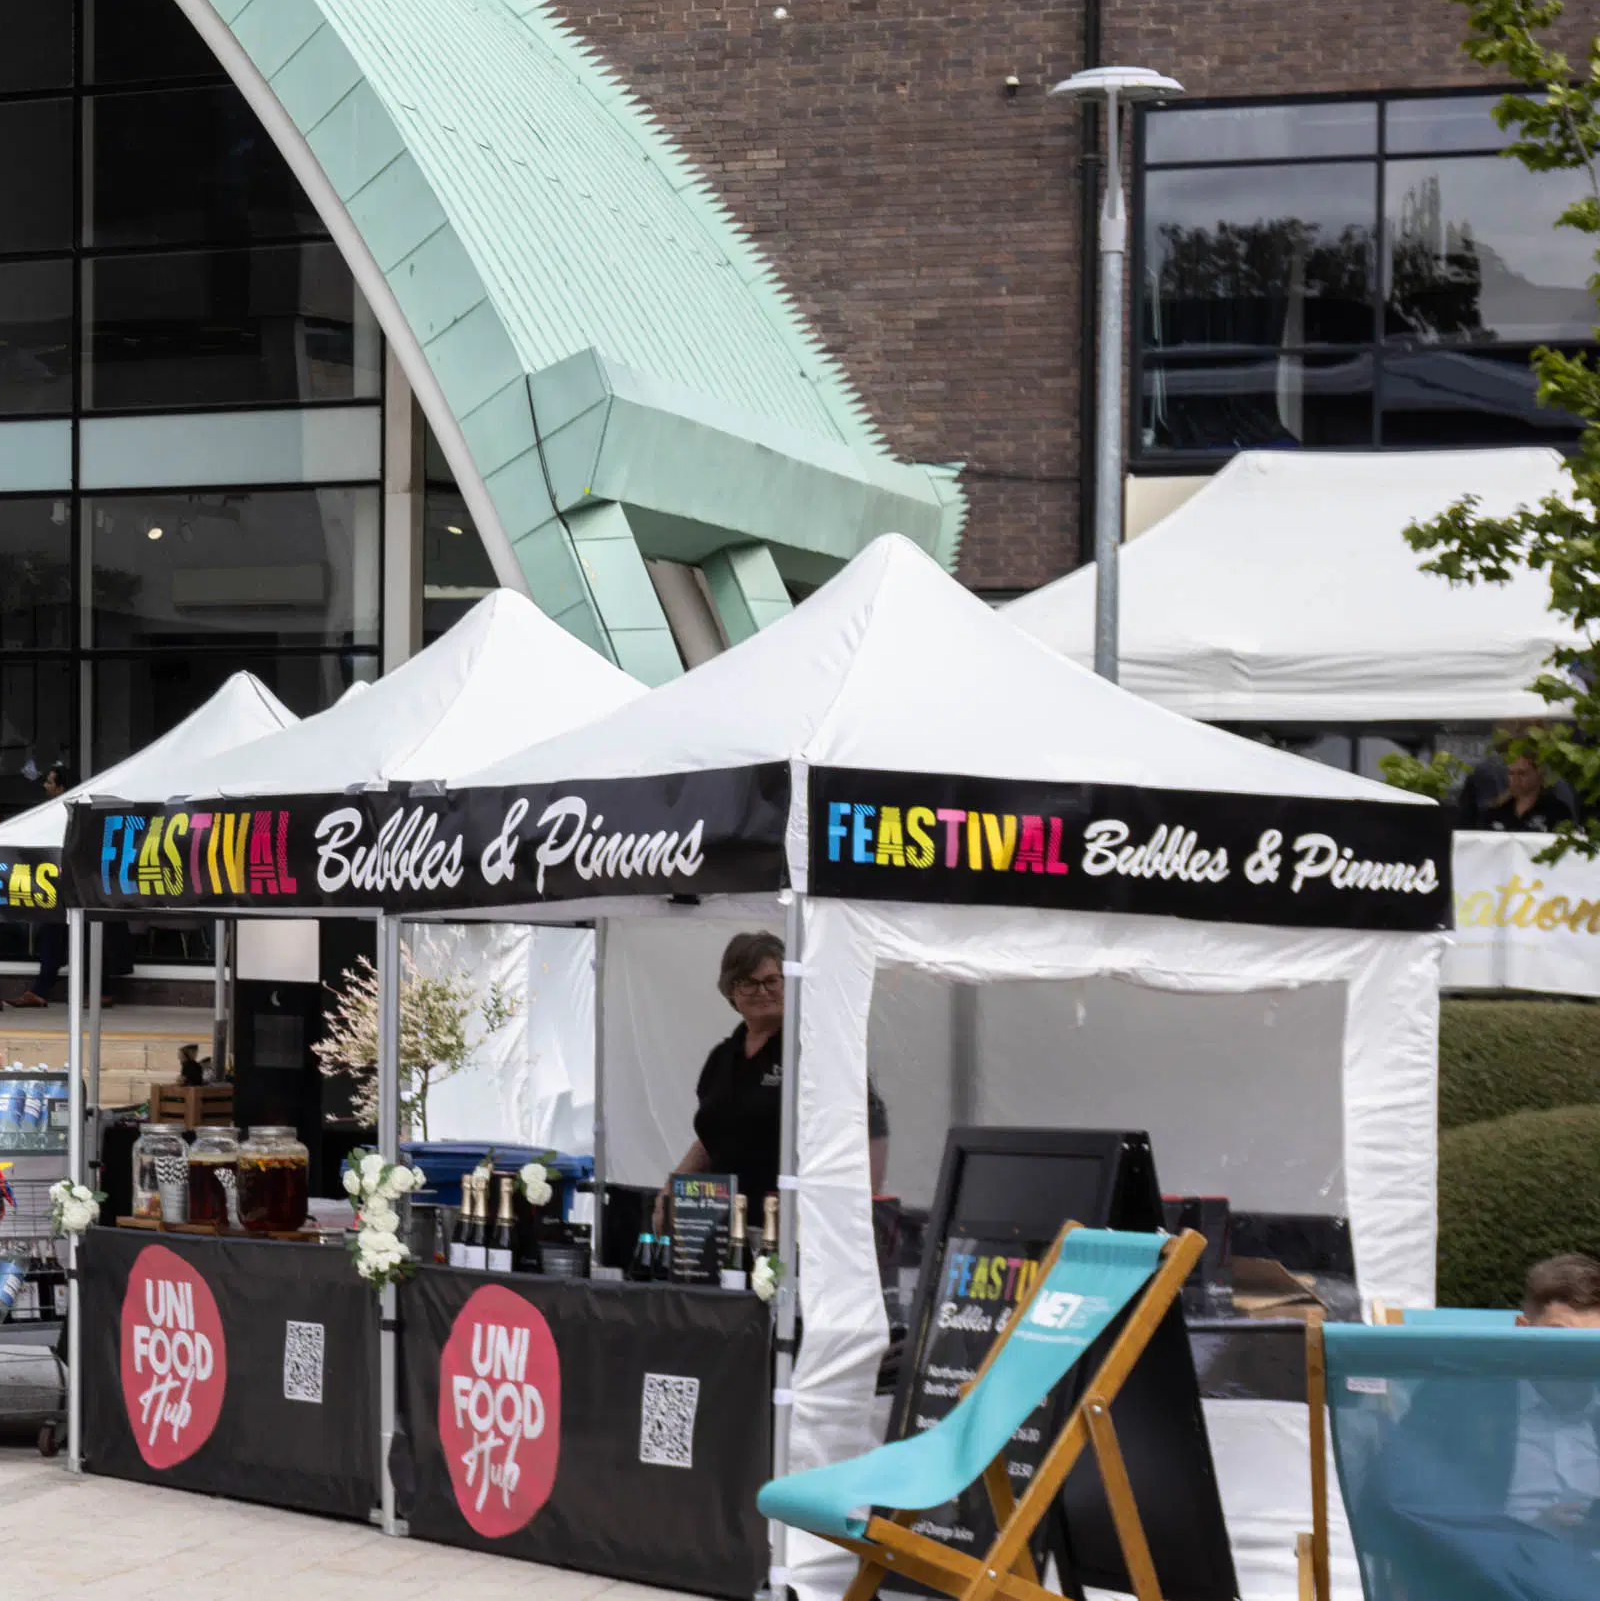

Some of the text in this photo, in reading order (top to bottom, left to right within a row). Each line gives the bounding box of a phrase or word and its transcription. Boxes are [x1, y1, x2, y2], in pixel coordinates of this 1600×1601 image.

[101, 796, 705, 896] FEASTIVAL Bubbles & Pimms
[827, 801, 1440, 894] FEASTIVAL Bubbles & Pimms
[1454, 873, 1600, 935] ation
[145, 1278, 195, 1330] UNI
[938, 1302, 993, 1333] Bubbles
[133, 1324, 214, 1381] FOOD
[471, 1322, 530, 1382] UNI
[138, 1366, 196, 1447] Hub
[452, 1375, 545, 1439] FOOD
[461, 1422, 522, 1512] Hub
